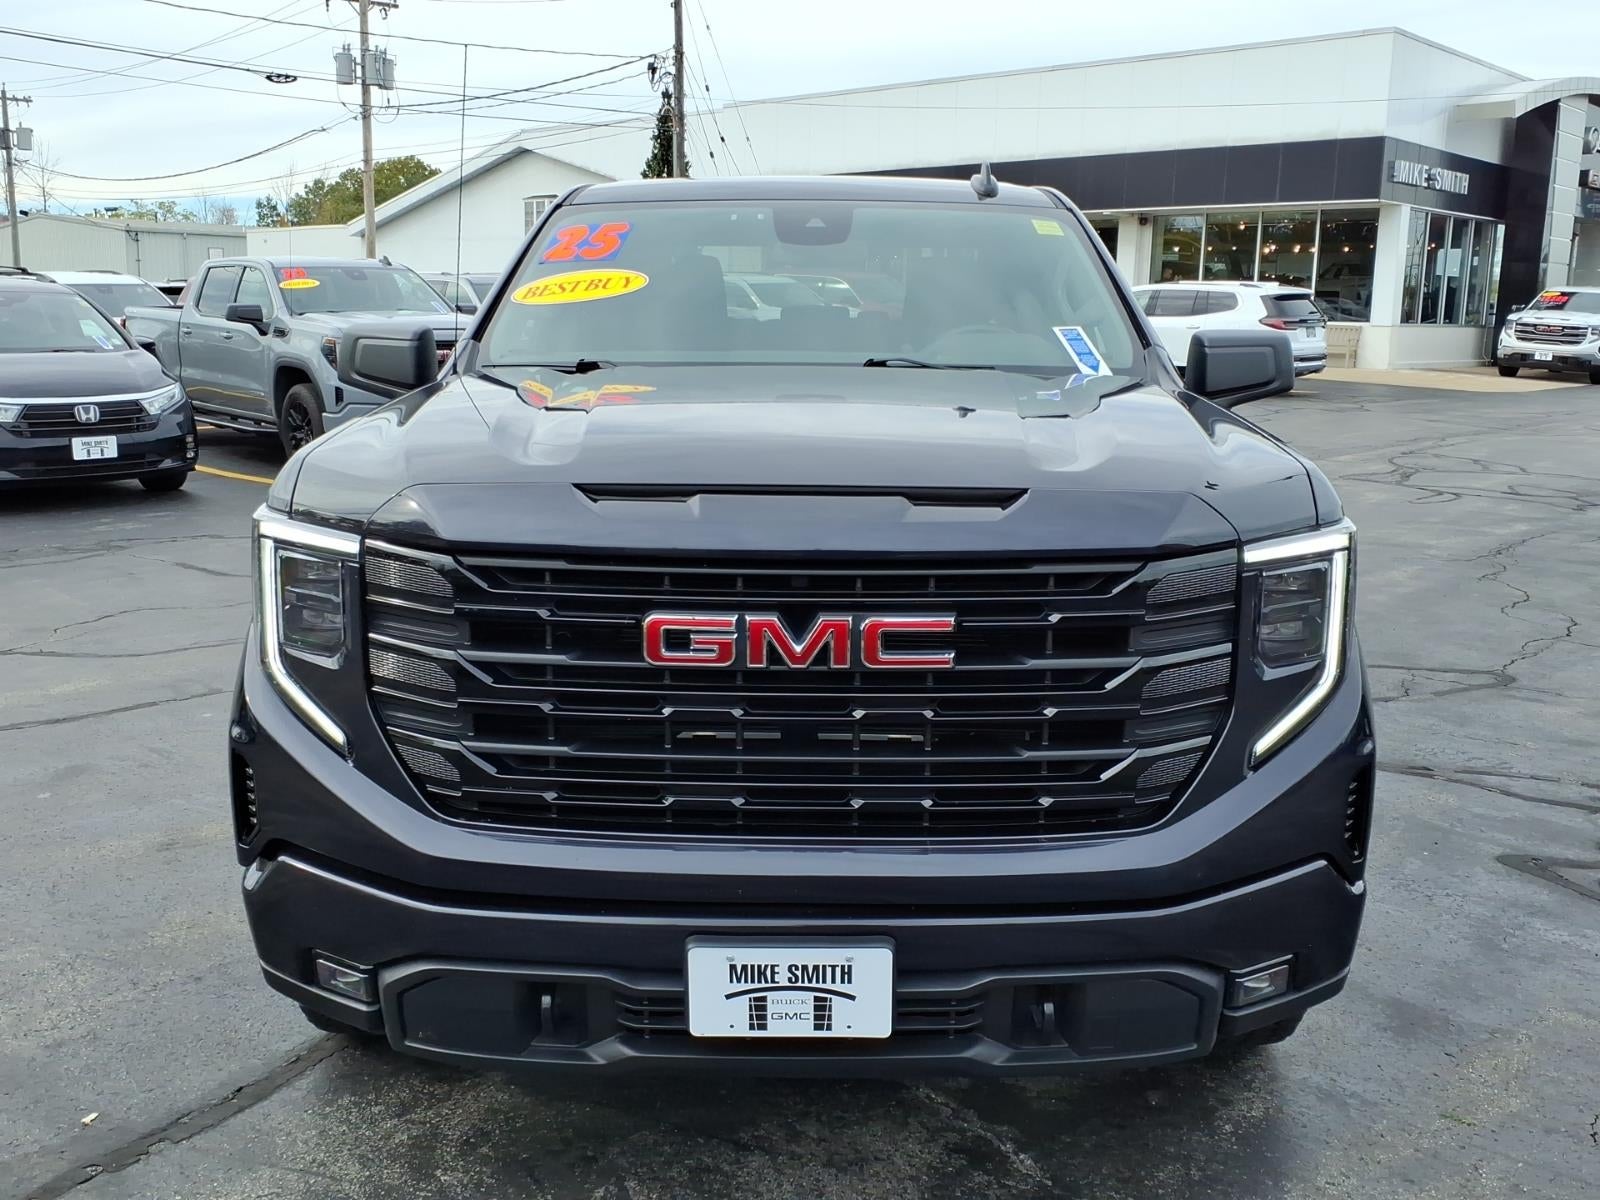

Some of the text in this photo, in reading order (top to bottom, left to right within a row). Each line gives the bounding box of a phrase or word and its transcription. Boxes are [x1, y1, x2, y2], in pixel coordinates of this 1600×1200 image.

[1395, 160, 1469, 195] MIKE SMITH
[543, 222, 630, 262] 25
[522, 276, 639, 299] BEST BUY
[642, 611, 956, 669] GMC
[729, 963, 853, 984] MIKE SMITH
[770, 1012, 811, 1021] GMC
